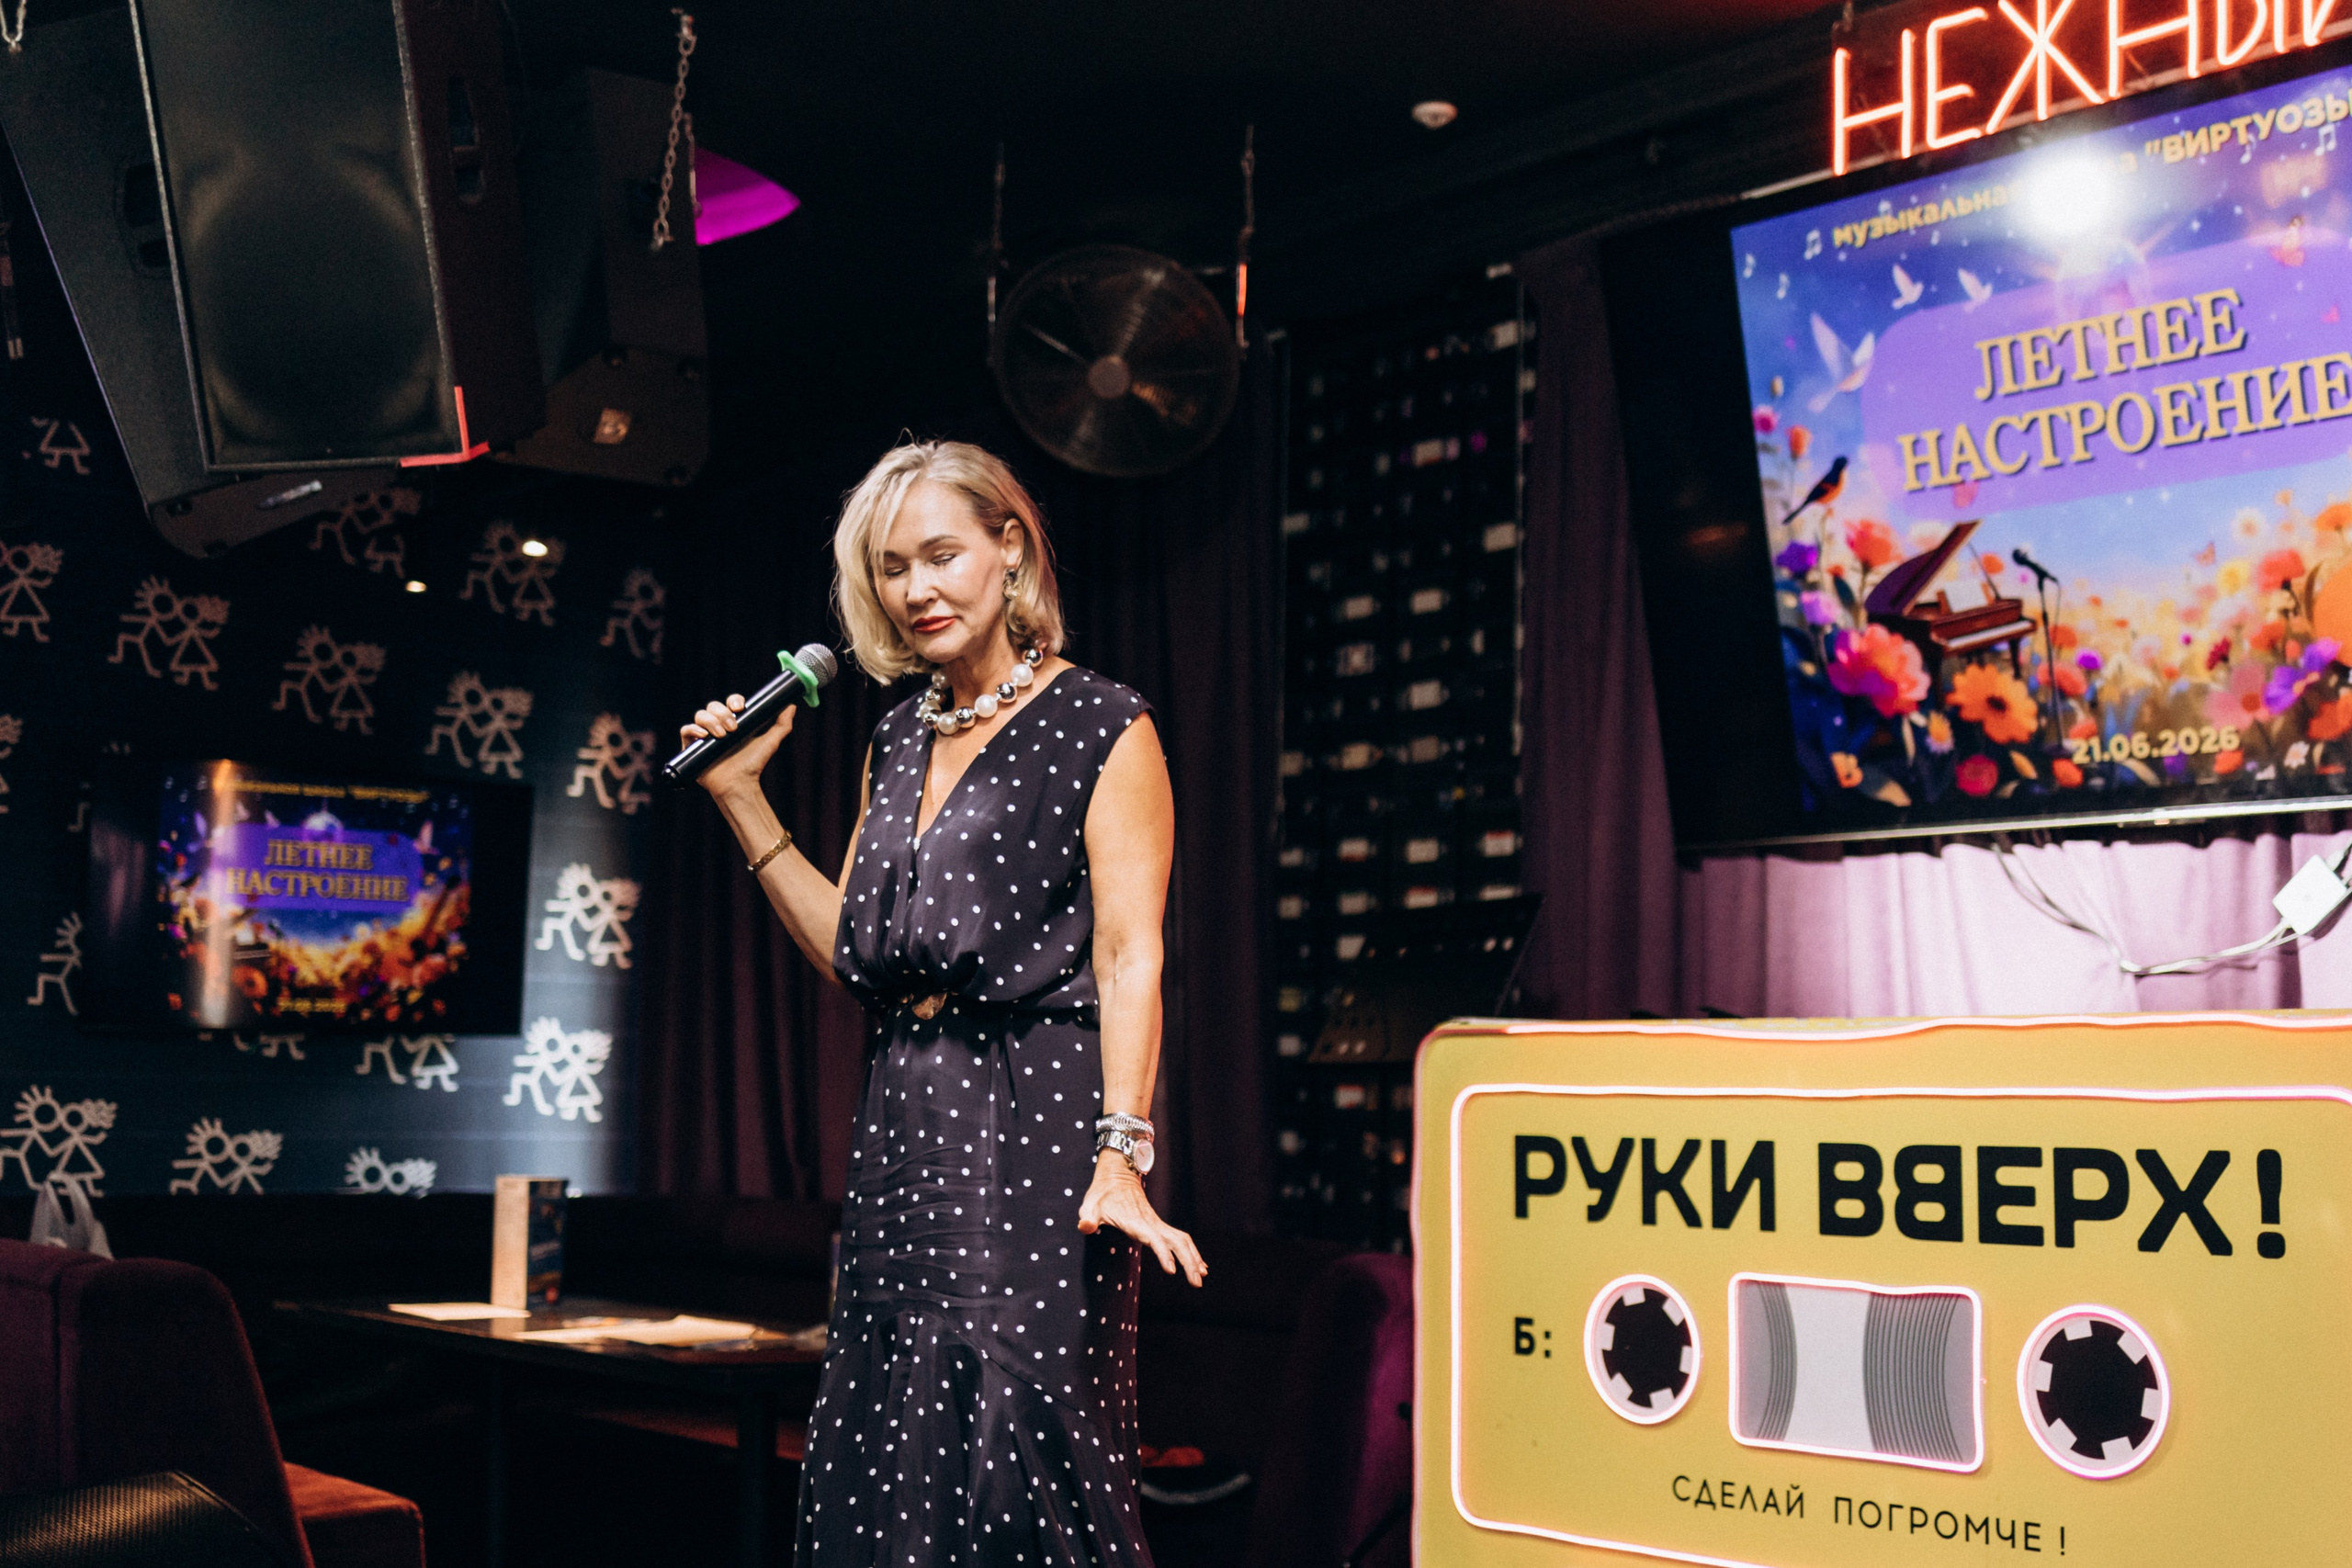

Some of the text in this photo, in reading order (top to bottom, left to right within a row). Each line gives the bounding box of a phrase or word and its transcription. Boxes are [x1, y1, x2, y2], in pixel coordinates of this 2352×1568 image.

[1834, 0, 2339, 175] НЕЖНЫ
[1832, 178, 2024, 249] музыкальна
[1974, 288, 2247, 401] ЛЕТНЕЕ
[1897, 352, 2352, 492] НАСТРОЕНИЕ
[2071, 726, 2241, 765] 21.06.2026
[264, 839, 373, 871] ЛЕТНЕЕ
[226, 868, 410, 903] НАСТРОЕНИЕ
[1513, 1134, 1778, 1234] РУКИ
[1513, 1315, 1553, 1359] Б:
[1672, 1474, 1804, 1519] СДЕЛАЙ
